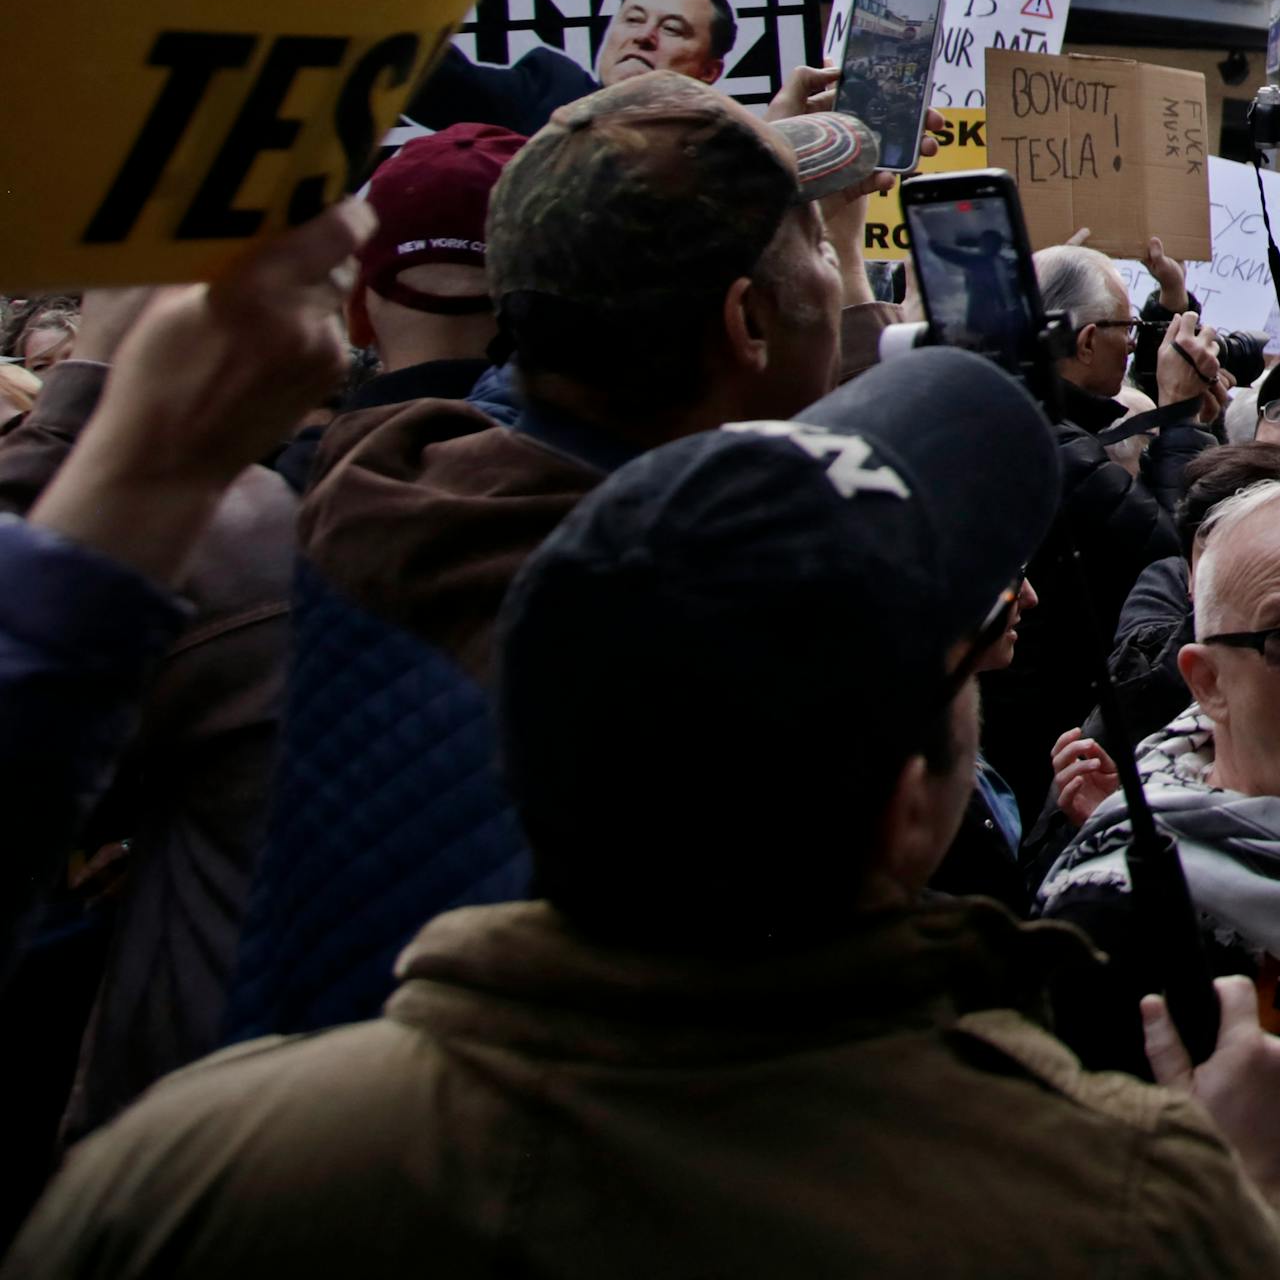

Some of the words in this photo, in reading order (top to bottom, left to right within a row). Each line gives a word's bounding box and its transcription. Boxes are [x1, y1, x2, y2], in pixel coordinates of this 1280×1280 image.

[1012, 67, 1118, 118] BOYCOTT
[84, 29, 422, 245] TES
[932, 120, 986, 147] SK
[1162, 96, 1180, 158] MUSK
[1184, 99, 1203, 175] FUCK
[397, 238, 427, 255] NEW
[429, 237, 469, 250] YORK
